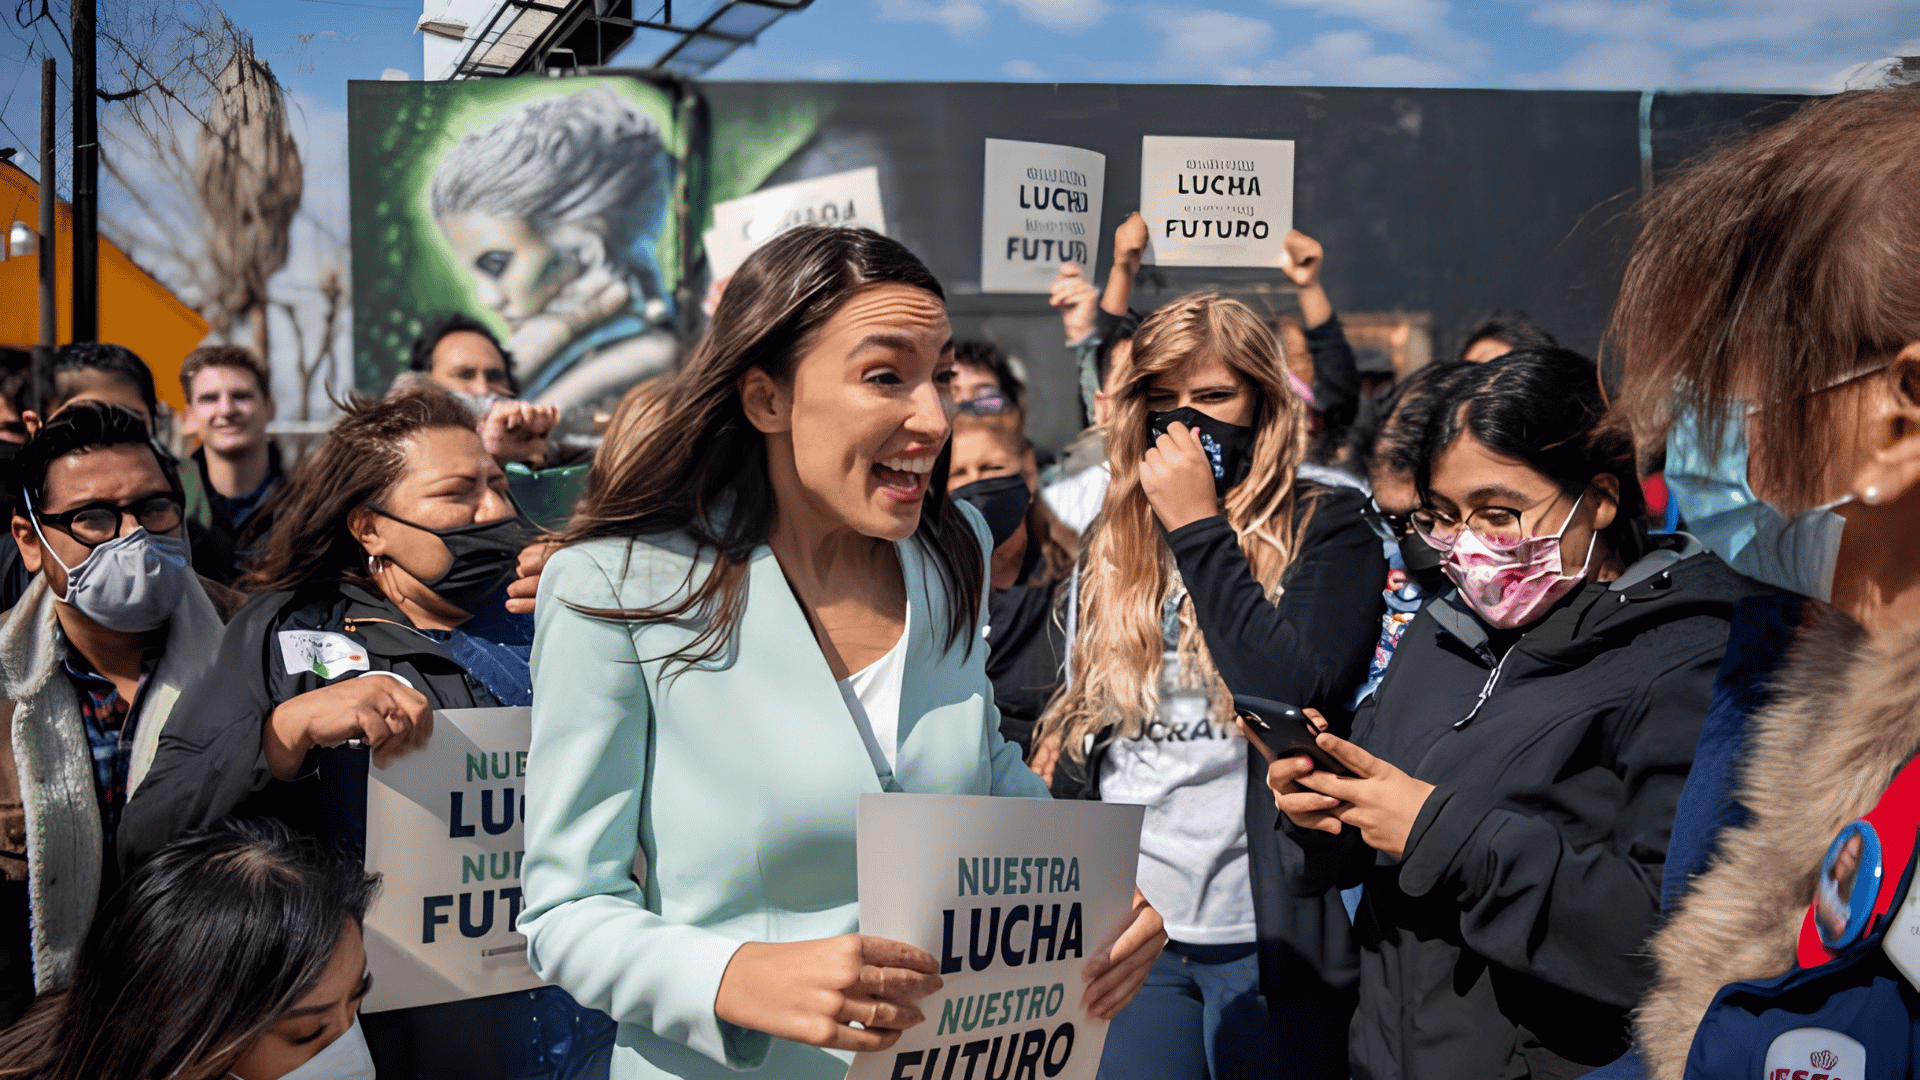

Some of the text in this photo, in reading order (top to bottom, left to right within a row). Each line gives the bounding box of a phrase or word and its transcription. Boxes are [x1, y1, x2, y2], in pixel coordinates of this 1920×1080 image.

[1179, 174, 1261, 197] LUCHA
[1166, 219, 1269, 240] FUTURO
[449, 788, 525, 839] LU
[958, 857, 1081, 897] NUESTRA
[940, 902, 1083, 975] LUCHA
[937, 983, 1065, 1036] NUESTRO
